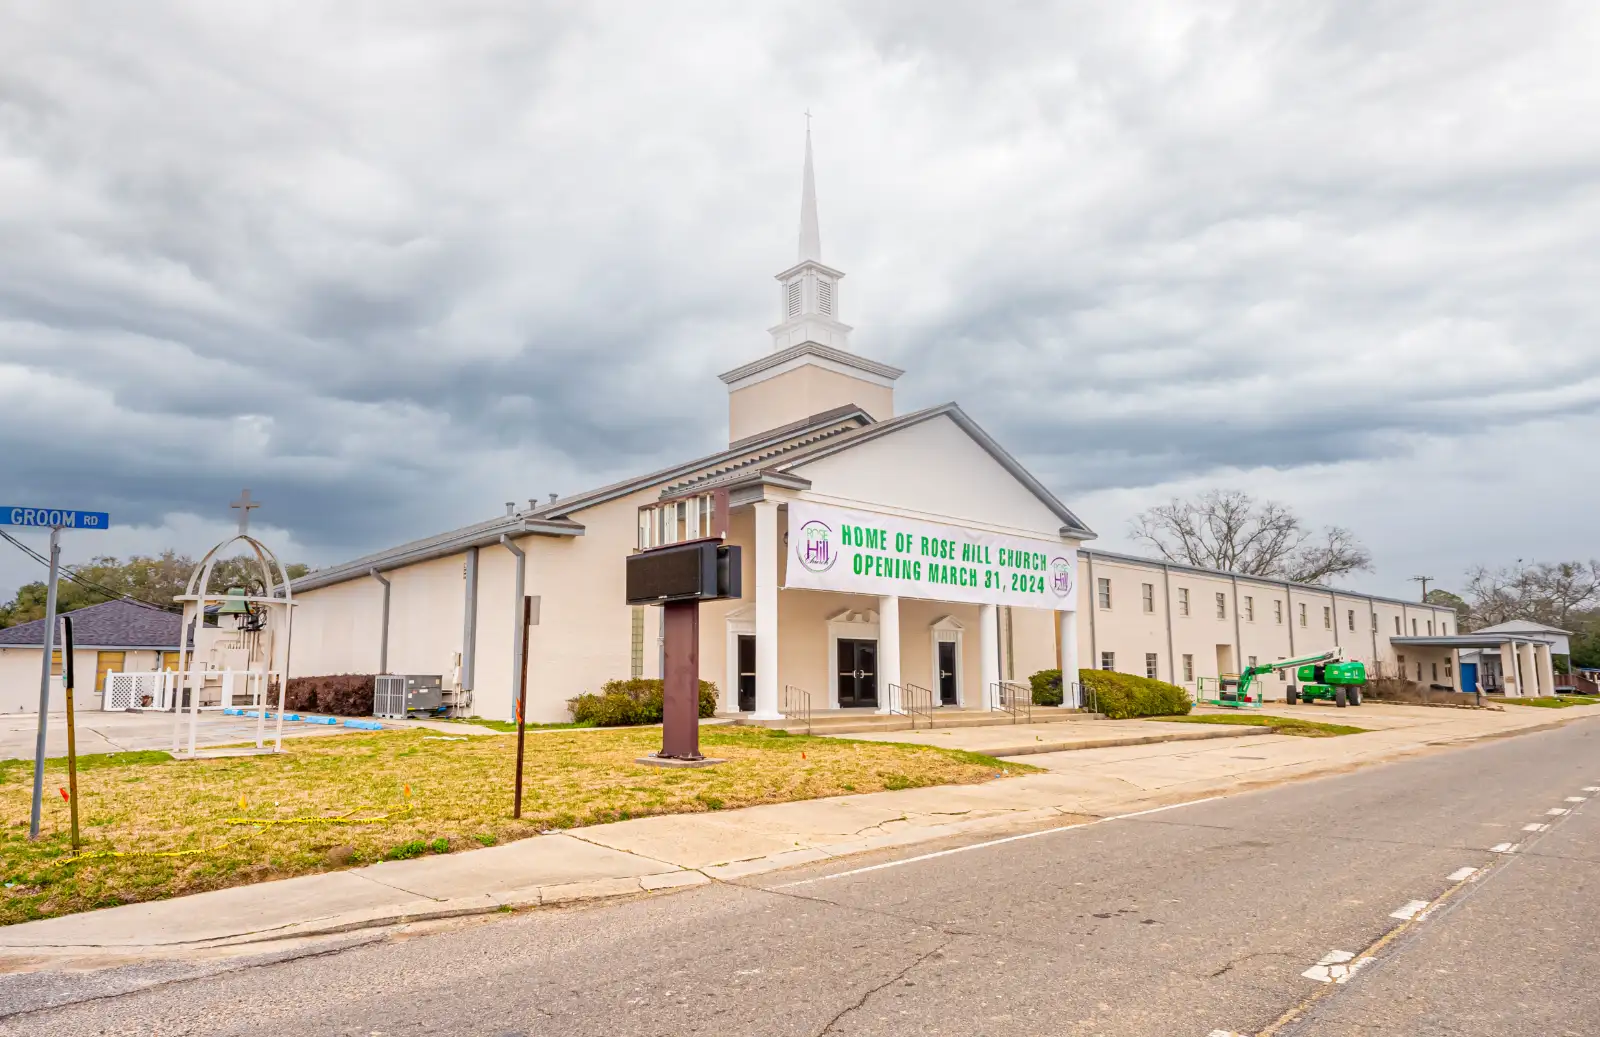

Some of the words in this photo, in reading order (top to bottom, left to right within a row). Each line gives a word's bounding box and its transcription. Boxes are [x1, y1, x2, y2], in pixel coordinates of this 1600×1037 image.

[10, 508, 76, 527] GROOM
[83, 515, 98, 526] RD
[806, 540, 829, 561] Hill
[841, 524, 887, 550] HOME
[895, 532, 913, 553] OF
[921, 536, 956, 560] ROSE
[962, 543, 991, 565] HILL
[998, 548, 1047, 571] CHURCH
[853, 553, 921, 581] OPENING
[928, 563, 977, 587] MARCH
[984, 570, 1006, 593] 31,
[1011, 573, 1045, 594] 2024
